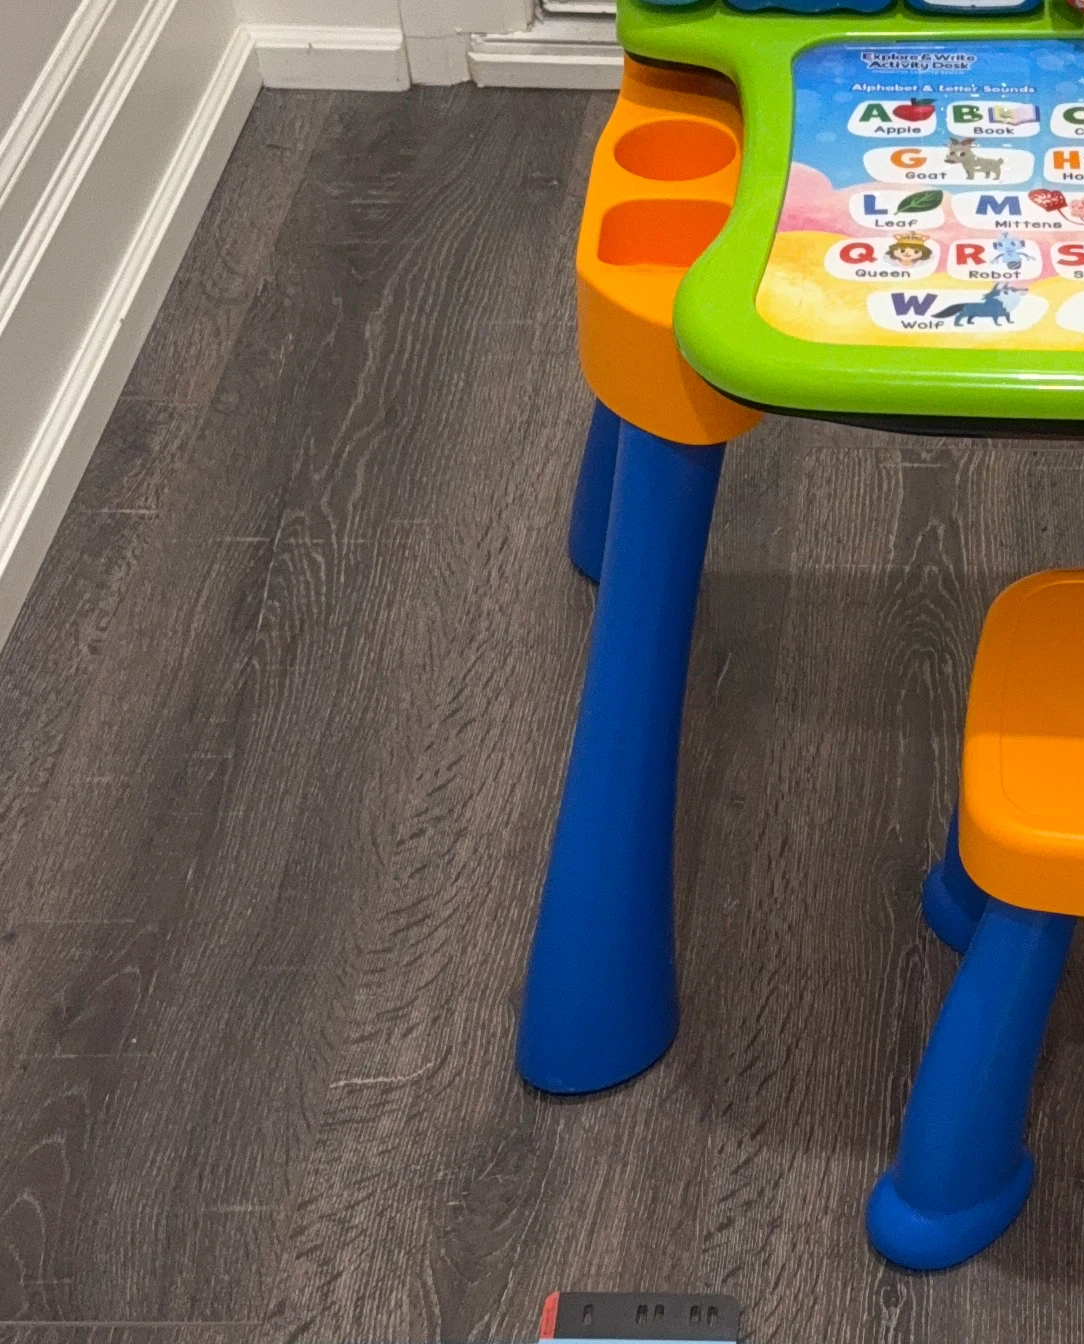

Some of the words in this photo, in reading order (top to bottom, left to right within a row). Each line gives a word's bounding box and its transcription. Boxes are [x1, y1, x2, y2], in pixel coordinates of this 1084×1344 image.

[862, 53, 919, 62] Explore
[935, 54, 976, 62] Write
[868, 61, 929, 70] Activity
[852, 83, 918, 93] Alphabet
[922, 84, 933, 92] &
[939, 84, 978, 93] Letter
[983, 85, 1036, 94] Sounds
[859, 103, 892, 122] A
[952, 105, 984, 124] B
[874, 126, 922, 135] Apple
[973, 126, 1014, 135] Book
[890, 149, 928, 169] G
[1052, 151, 1082, 170] H
[904, 171, 948, 180] Goat
[863, 194, 888, 216] L
[975, 194, 1022, 216] M
[874, 219, 918, 228] Leaf
[994, 220, 1062, 229] Mittens
[839, 242, 878, 264] Q
[956, 244, 986, 265] R
[854, 269, 911, 279] Queen
[968, 270, 1021, 280] Robot
[890, 292, 938, 316] W
[901, 320, 945, 330] Wolf
